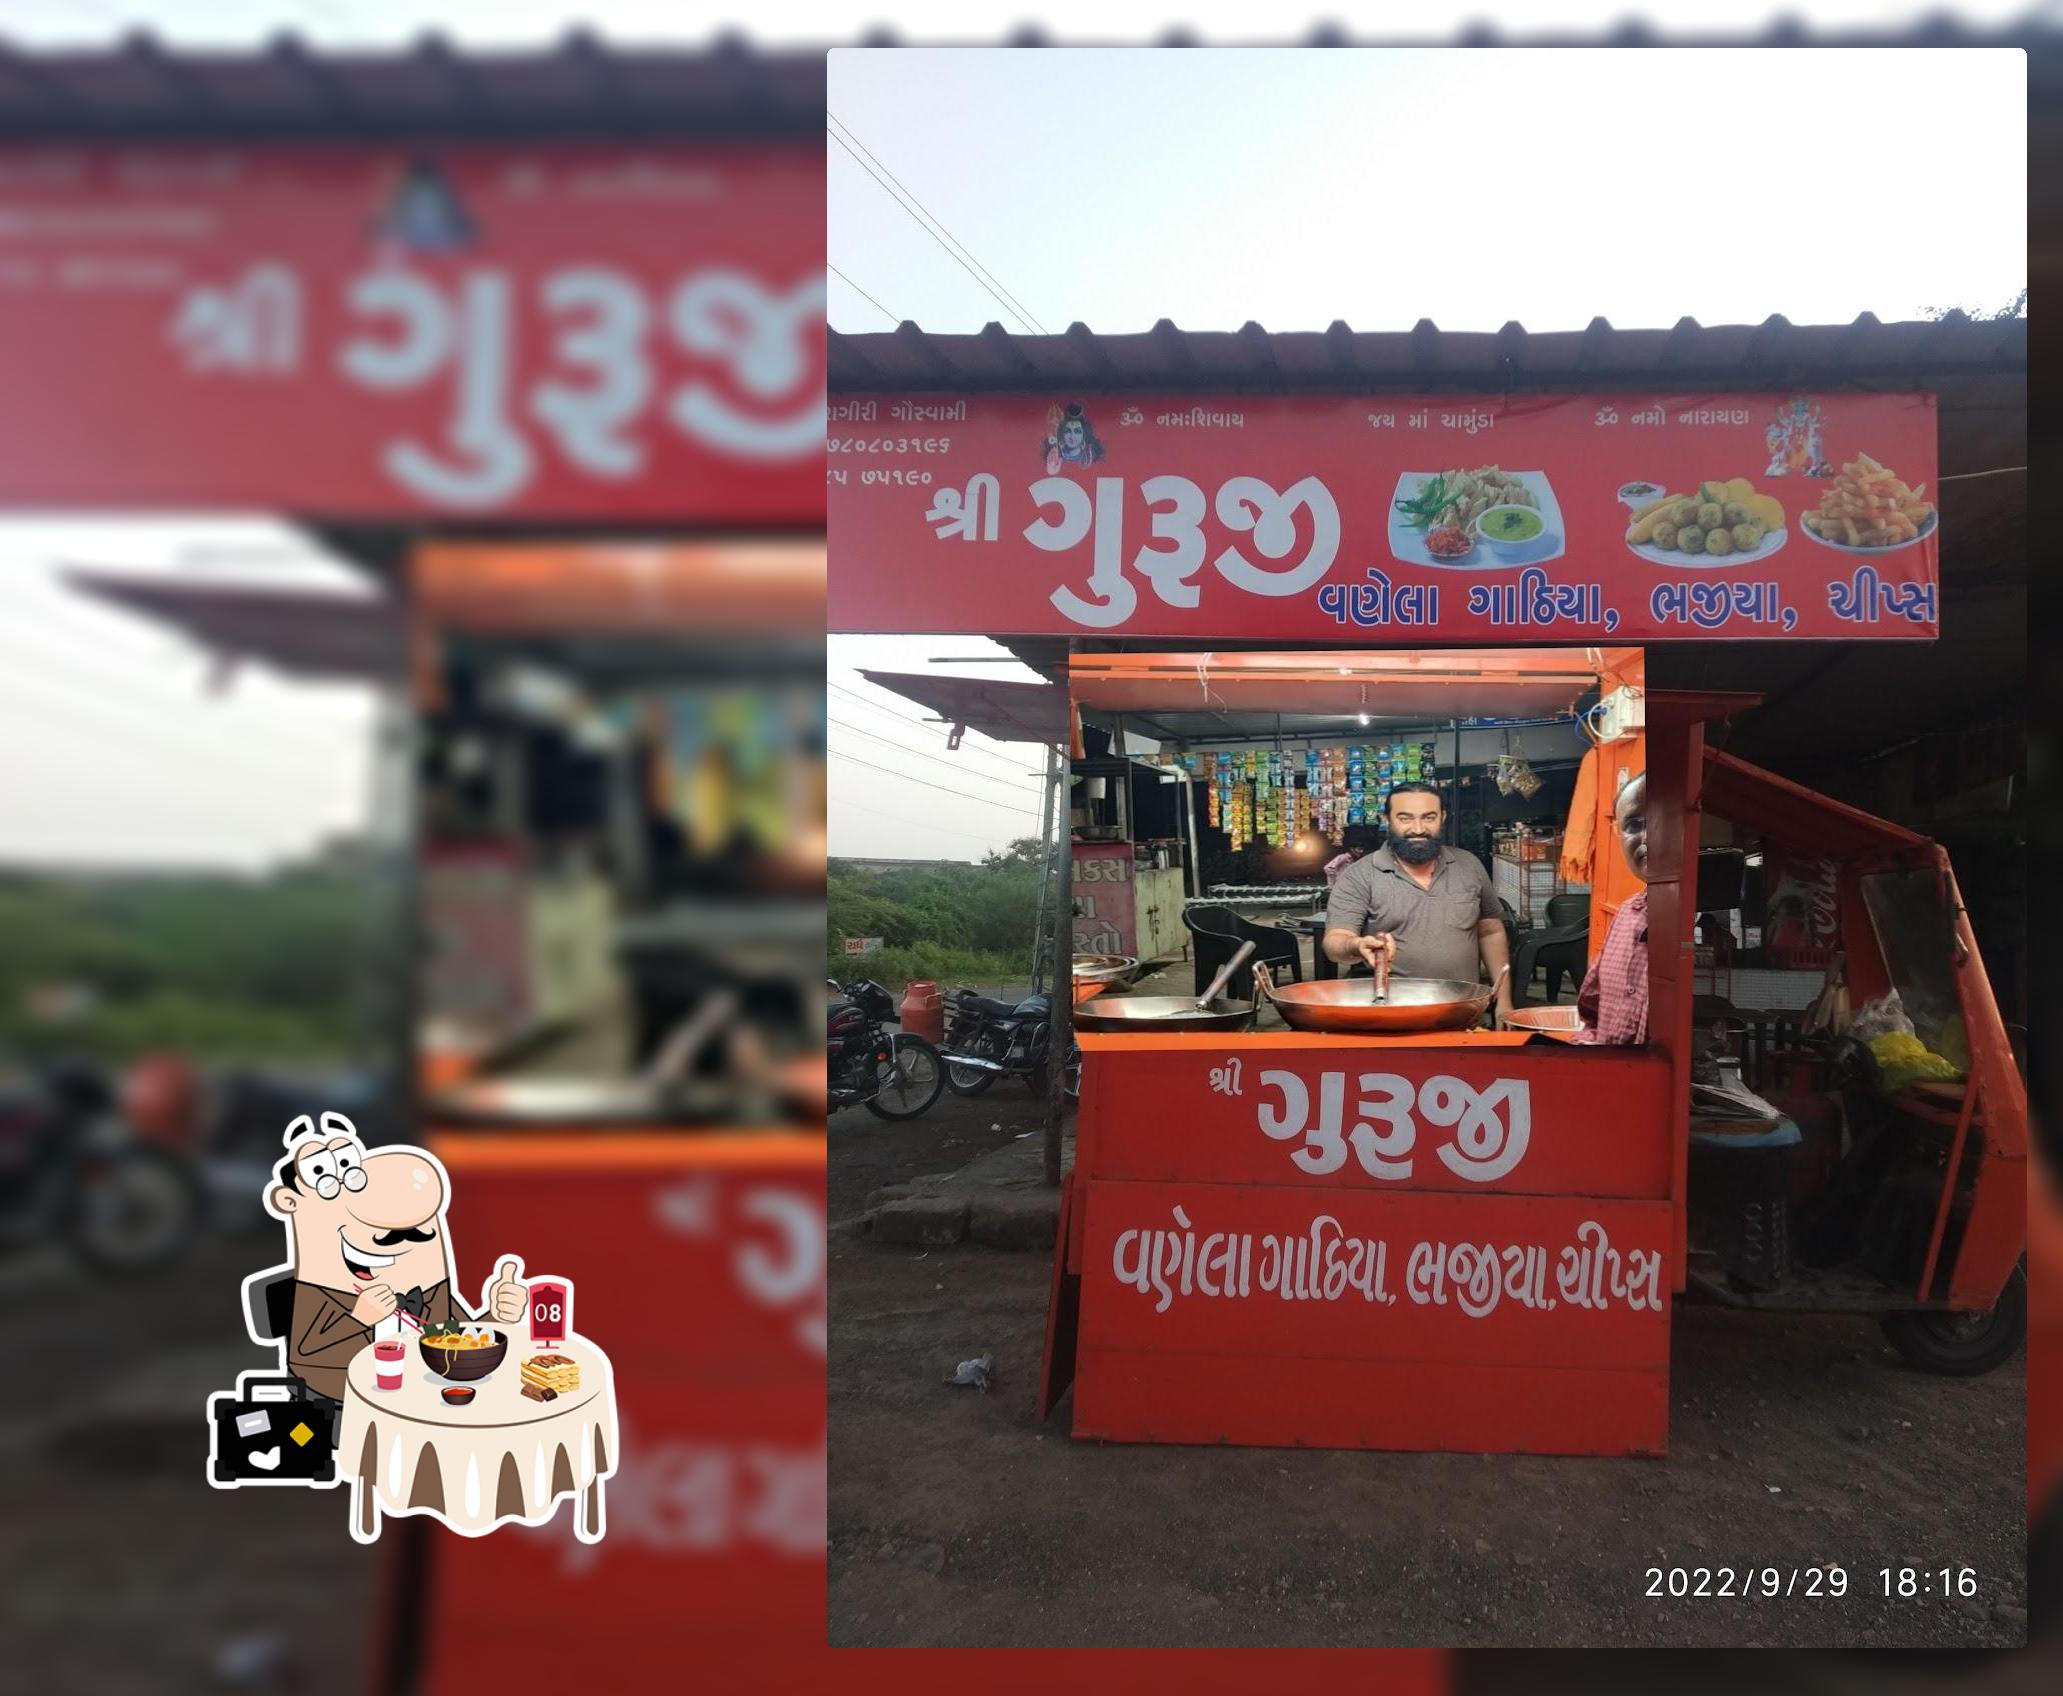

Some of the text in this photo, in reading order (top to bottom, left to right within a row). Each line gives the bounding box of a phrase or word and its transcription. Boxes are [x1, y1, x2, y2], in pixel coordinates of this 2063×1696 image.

[891, 400, 966, 421] ગોસ્વામી
[1368, 408, 1494, 434] જય માં ચામુંડા
[1631, 404, 1665, 425] નમો
[1678, 409, 1749, 426] નારાયણ
[861, 470, 932, 485] ૭૫૧૯૦
[925, 472, 1000, 541] શ્રી
[1318, 565, 1936, 633] વણેલા ગાઠિયા, ભજીયા, ચીપ્સ
[1209, 1057, 1242, 1096] શ્રી
[1112, 1204, 1252, 1313] વણેલા
